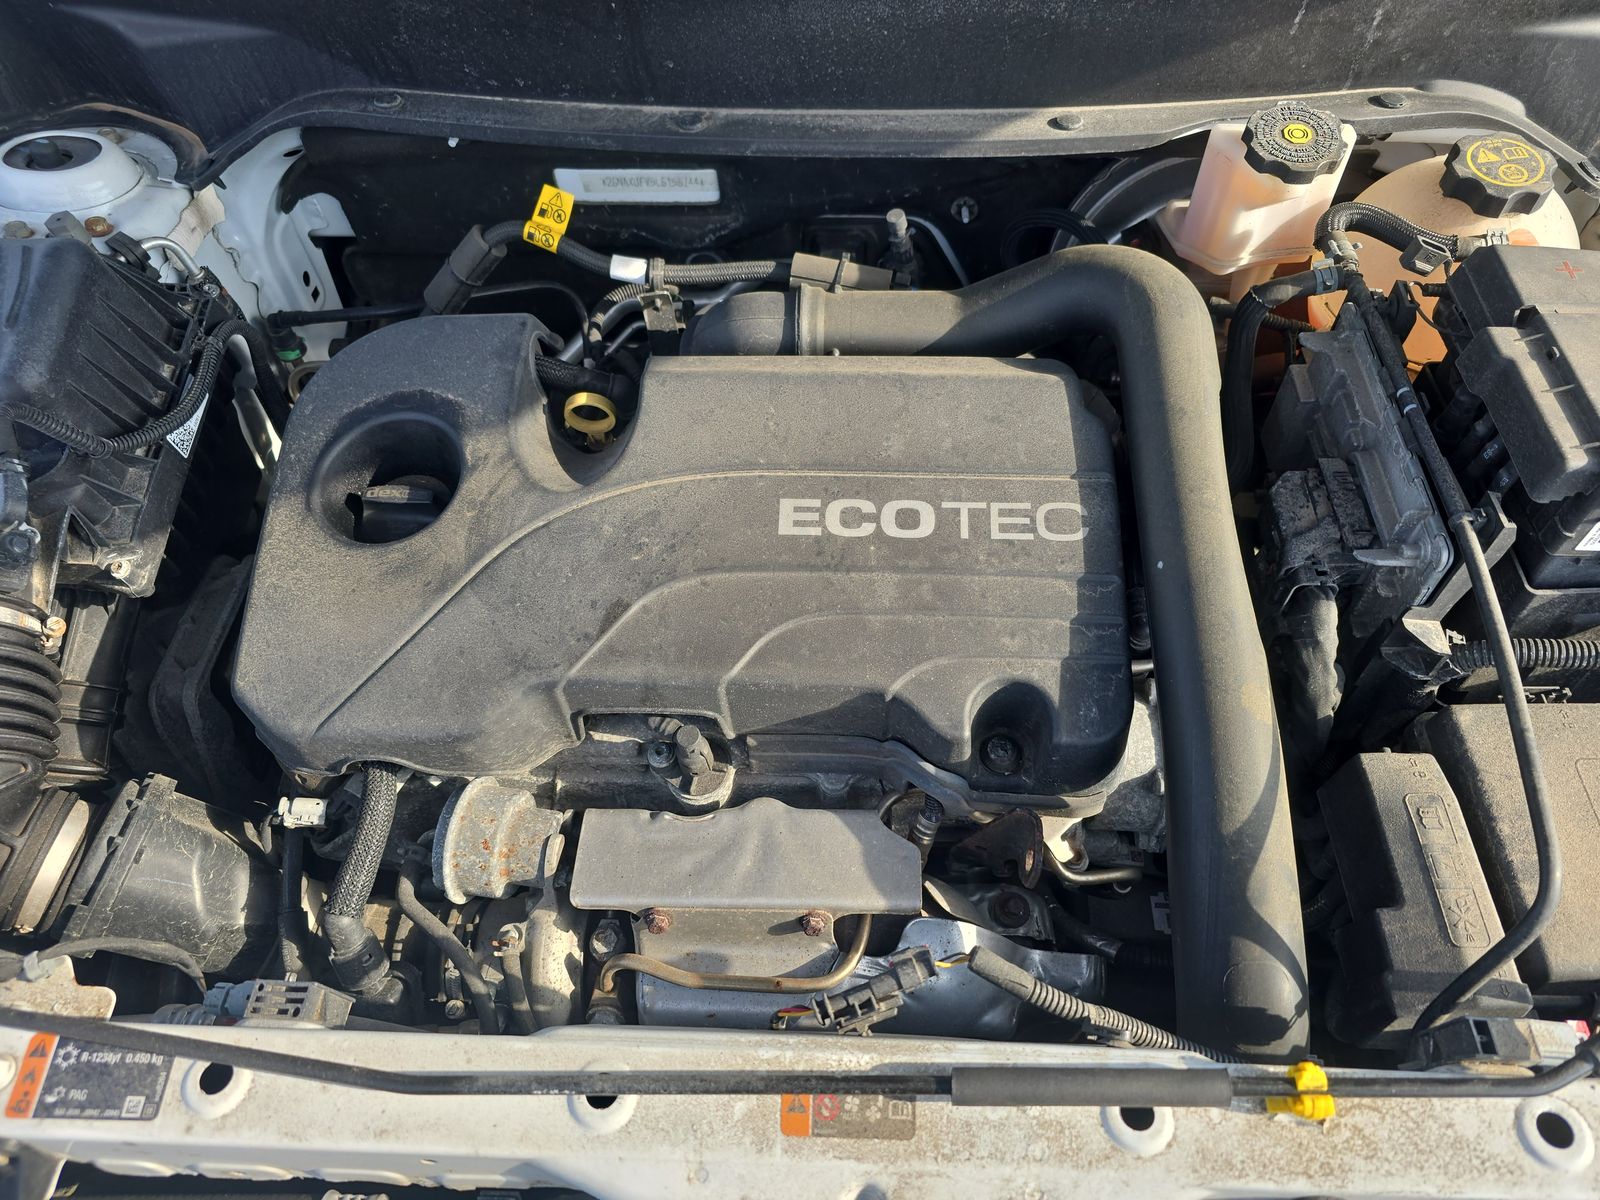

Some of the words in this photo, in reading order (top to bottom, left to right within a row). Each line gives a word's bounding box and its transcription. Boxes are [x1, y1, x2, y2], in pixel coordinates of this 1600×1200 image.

[778, 498, 1089, 541] ECOTEC
[125, 1053, 151, 1064] 0.450
[151, 1053, 164, 1066] kg
[68, 1089, 88, 1100] PAG
